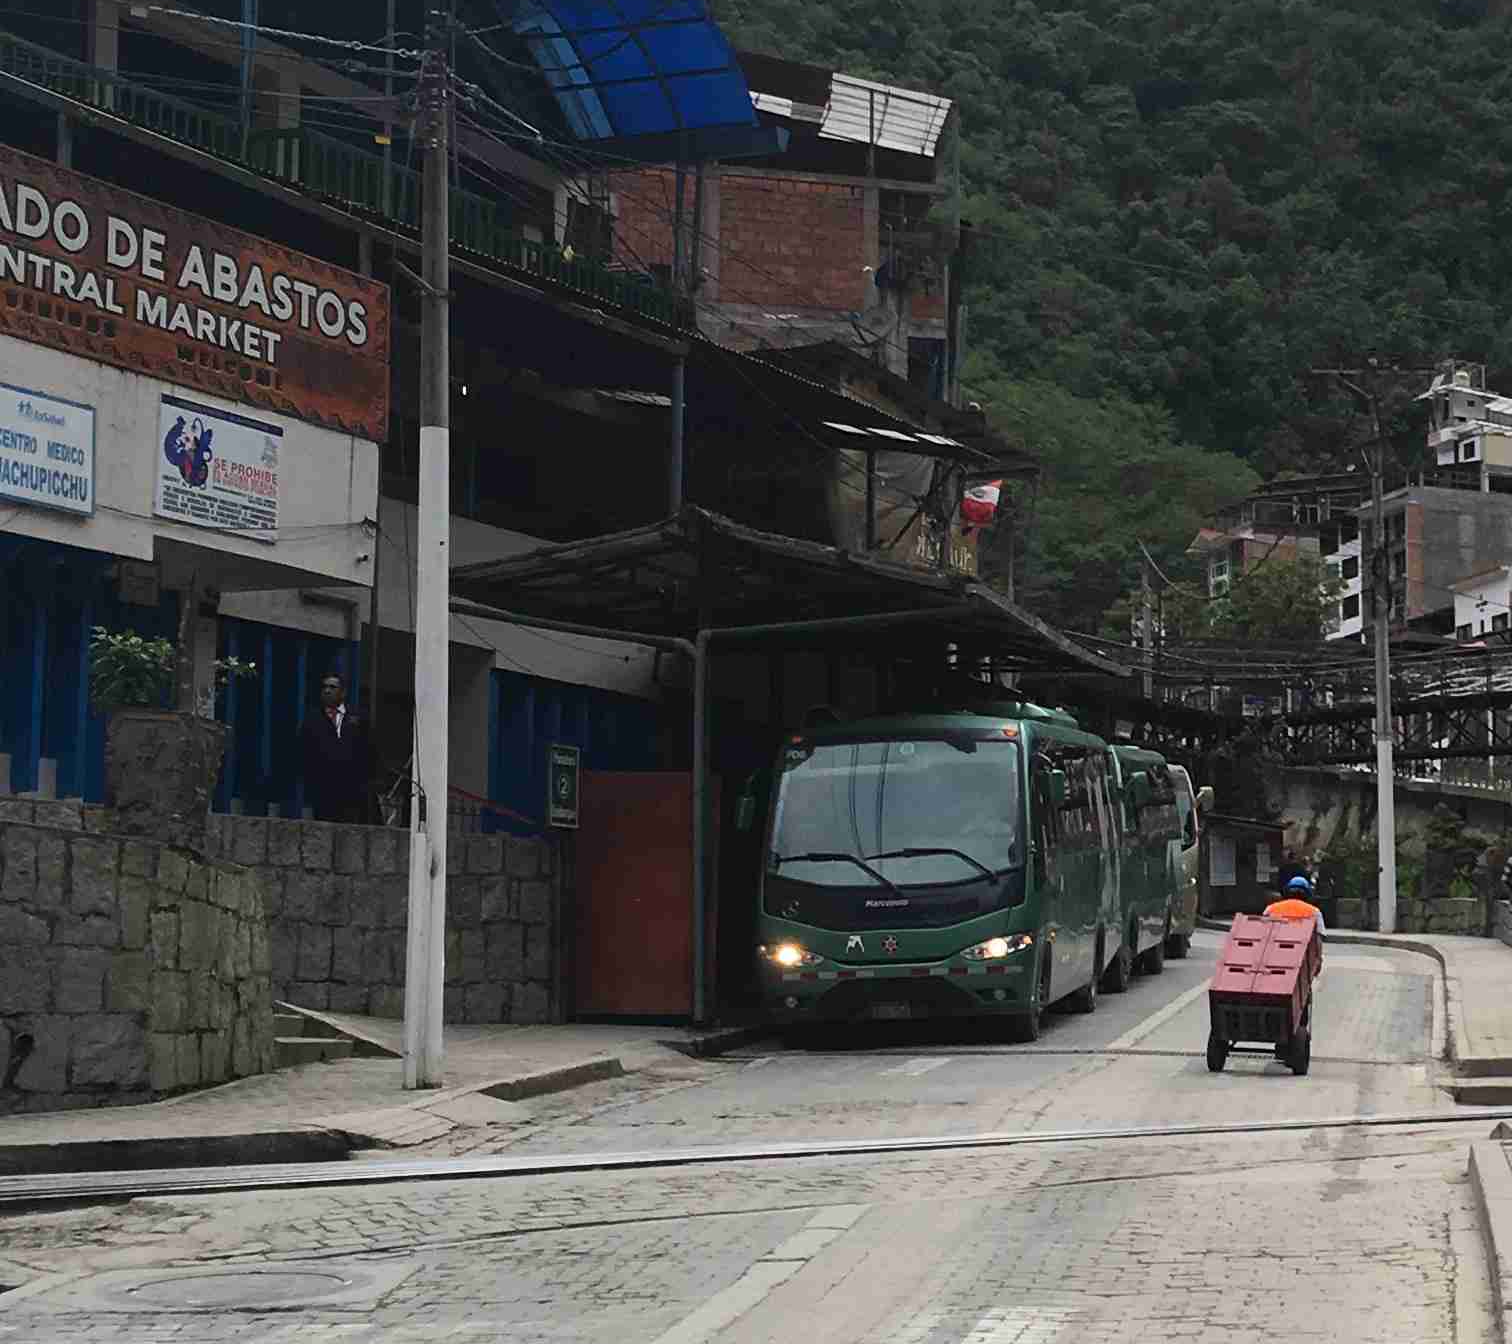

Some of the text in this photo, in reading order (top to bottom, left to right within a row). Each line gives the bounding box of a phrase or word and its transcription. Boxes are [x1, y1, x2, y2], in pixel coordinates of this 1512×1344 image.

[0, 244, 281, 363] NTRAL MARKET
[107, 216, 167, 280] DE
[178, 246, 367, 345] ABASTOS
